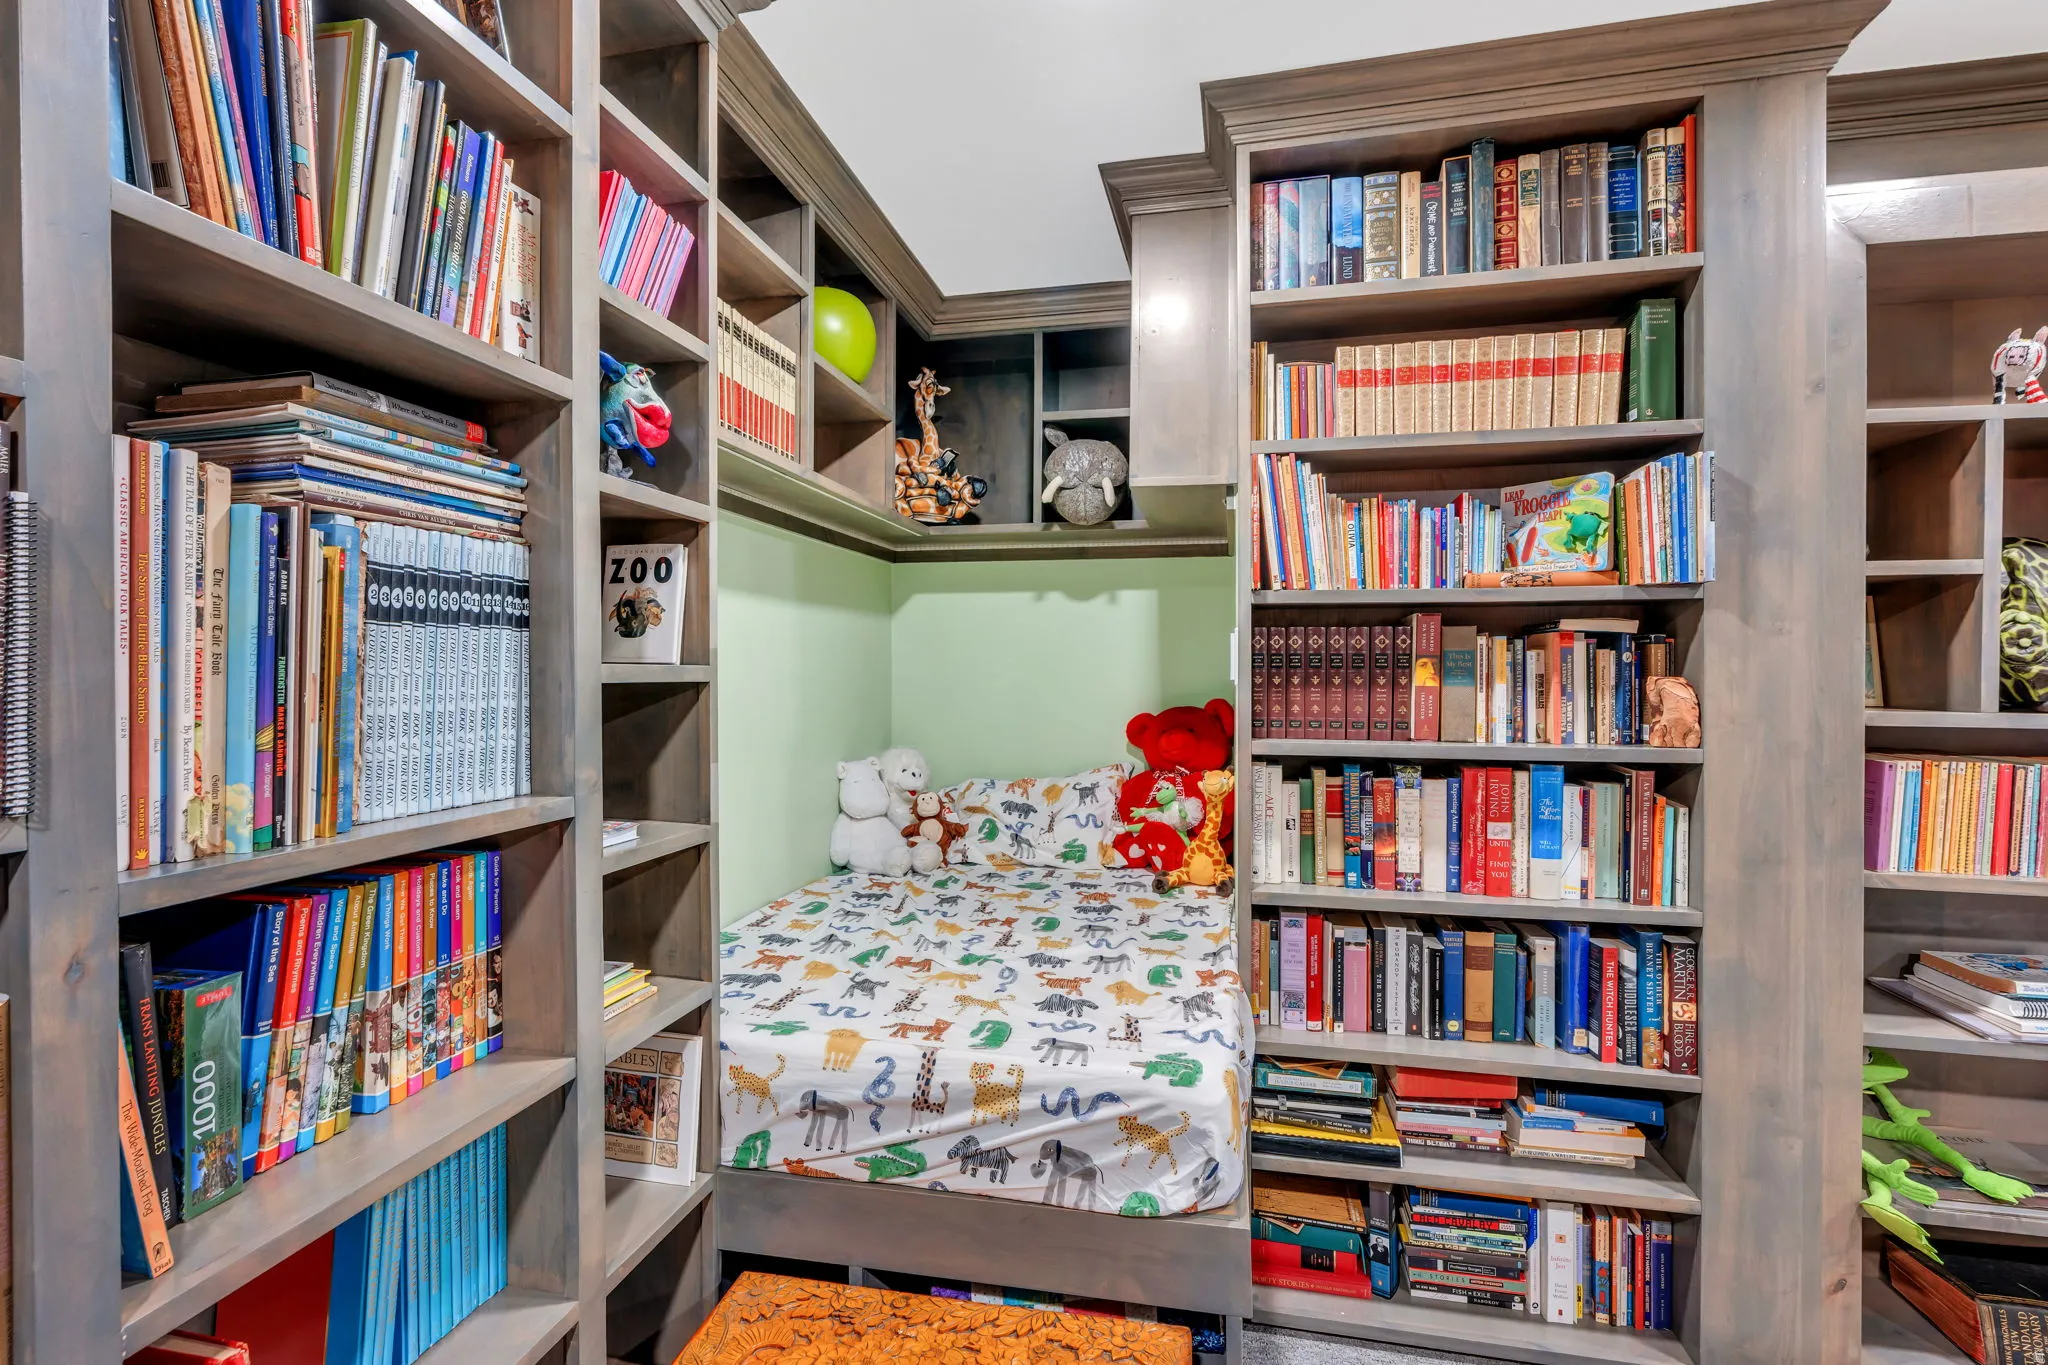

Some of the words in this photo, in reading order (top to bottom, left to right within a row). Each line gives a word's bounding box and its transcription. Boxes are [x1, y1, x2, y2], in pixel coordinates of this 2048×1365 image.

[464, 154, 474, 182] Rathmann
[494, 156, 502, 178] DAVID
[459, 190, 469, 215] GOOD
[490, 180, 500, 212] WIESNER
[500, 189, 508, 203] VERY
[446, 195, 456, 229] TUESDAY
[498, 205, 506, 226] HUNGRY
[1427, 202, 1438, 224] CRIME
[482, 224, 494, 273] FLOTSAM
[494, 228, 504, 264] CATERPILLAR
[526, 233, 537, 249] My
[449, 242, 461, 279] GORILLA
[1343, 256, 1352, 279] LUND
[445, 286, 454, 309] Putnam
[391, 402, 410, 414] Where
[411, 409, 420, 418] the
[421, 410, 444, 425] Sidewalk
[0, 446, 8, 474] MAIER
[184, 466, 194, 486] THE
[120, 483, 128, 526] CLASSIC
[184, 488, 194, 513] TALE
[1504, 490, 1524, 502] LEAP
[184, 514, 194, 528] OF
[399, 510, 417, 519] CHRIS
[1538, 510, 1562, 523] LEAP!
[120, 530, 128, 584] AMERICAN
[184, 529, 194, 560] PETER
[138, 553, 148, 572] The
[136, 576, 148, 604] Story
[184, 563, 194, 598] RABBIT
[212, 568, 224, 588] The
[280, 570, 288, 590] ADAM
[120, 588, 128, 614] FOLK
[210, 592, 222, 620] Fairy
[280, 592, 288, 606] REX
[382, 590, 389, 602] 3
[393, 592, 400, 602] 4
[136, 607, 148, 619] of
[120, 619, 128, 648] TALES
[138, 622, 148, 650] Little
[212, 624, 223, 648] Tale
[267, 616, 275, 637] Children
[368, 626, 376, 670] STORIES
[390, 628, 399, 670] STORIES
[138, 654, 148, 683] Black
[184, 644, 192, 686] CHERISHED
[211, 652, 222, 676] Book
[277, 656, 286, 704] FRANKENSTEIN
[388, 673, 397, 692] from
[138, 686, 148, 724] Sambo
[184, 687, 192, 714] STORIES
[180, 725, 192, 735] By
[276, 706, 285, 731] MAKES
[388, 714, 396, 742] BOOK
[184, 737, 192, 765] Beatrix
[276, 740, 285, 777] SANDWICH
[184, 768, 192, 792] Potter
[211, 774, 220, 800] Golden
[364, 758, 372, 809] MORMON
[386, 757, 395, 807] MORMON
[1266, 795, 1274, 818] ALICE
[1451, 784, 1459, 816] Expecting
[1490, 780, 1499, 818] IRVING
[1501, 784, 1510, 813] JOHN
[1539, 797, 1554, 806] The
[1254, 804, 1264, 842] EDWARD
[1490, 840, 1510, 848] UNTIL
[440, 868, 448, 888] Make
[352, 895, 361, 918] About
[368, 888, 376, 905] The
[272, 911, 284, 934] Story
[296, 907, 309, 936] Poems
[316, 904, 326, 940] Children
[334, 898, 344, 924] World
[364, 906, 374, 929] Green
[383, 902, 392, 929] Things
[454, 899, 462, 921] Learn
[272, 936, 282, 946] of
[296, 938, 304, 956] and
[348, 920, 358, 954] Animals
[359, 930, 371, 969] Kingdom
[271, 947, 281, 959] the
[328, 943, 339, 970] Space
[1646, 942, 1654, 978] BENNET
[1686, 948, 1695, 982] GEORGE
[268, 962, 278, 982] Sea
[290, 959, 303, 994] Rhymes
[308, 942, 322, 992] Everywhere
[1606, 962, 1614, 978] THE
[1674, 947, 1686, 1000] MARTIN
[1606, 982, 1614, 1008] WITCH
[1624, 982, 1638, 1032] MIDDLESEX
[1646, 982, 1654, 1013] SISTER
[139, 997, 154, 1037] FRANS
[1605, 1011, 1614, 1046] HUNTER
[1674, 1024, 1684, 1058] BLOOD
[1686, 1024, 1695, 1043] FIRE
[1686, 1046, 1696, 1056] &
[142, 1040, 160, 1097] LANTING
[122, 1100, 135, 1121] The
[192, 1060, 216, 1140] 1000
[147, 1099, 168, 1155] JUNGLES
[126, 1124, 150, 1186] Wide-Mouthed
[134, 1190, 155, 1216] Frog
[160, 1188, 171, 1220] TASCHEN
[153, 1260, 172, 1274] Dial
[1430, 1272, 1465, 1284] STORIES
[1278, 1278, 1310, 1288] STORIES
[2010, 1330, 2022, 1351] NEW
